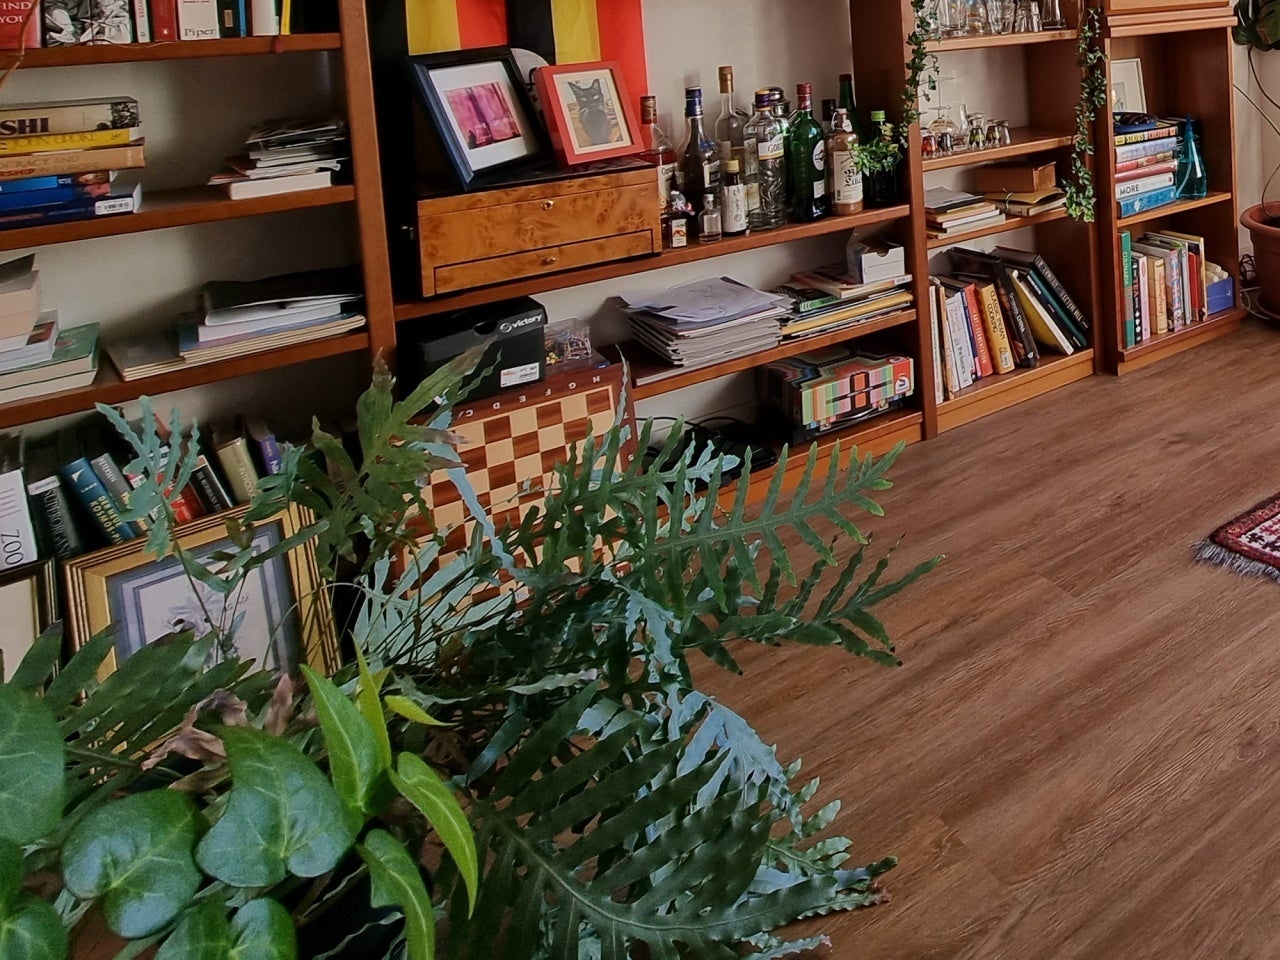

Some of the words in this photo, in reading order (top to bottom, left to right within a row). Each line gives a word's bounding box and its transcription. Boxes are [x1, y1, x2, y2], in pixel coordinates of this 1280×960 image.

[0, 2, 31, 10] IND
[184, 28, 215, 37] Piper
[1120, 184, 1140, 196] MORE
[1122, 251, 1130, 286] CULINARIA
[511, 314, 543, 329] victory
[986, 303, 999, 333] COOKING
[989, 290, 1001, 318] CLASSIC
[995, 318, 1006, 345] INDIAN
[1014, 315, 1027, 333] CHINA
[518, 395, 527, 403] E
[97, 457, 117, 483] PETERSEN
[43, 489, 71, 558] SUPERORGANI
[90, 500, 124, 545] KOSMOS-PI
[98, 495, 111, 510] DER
[107, 508, 123, 527] NEUE
